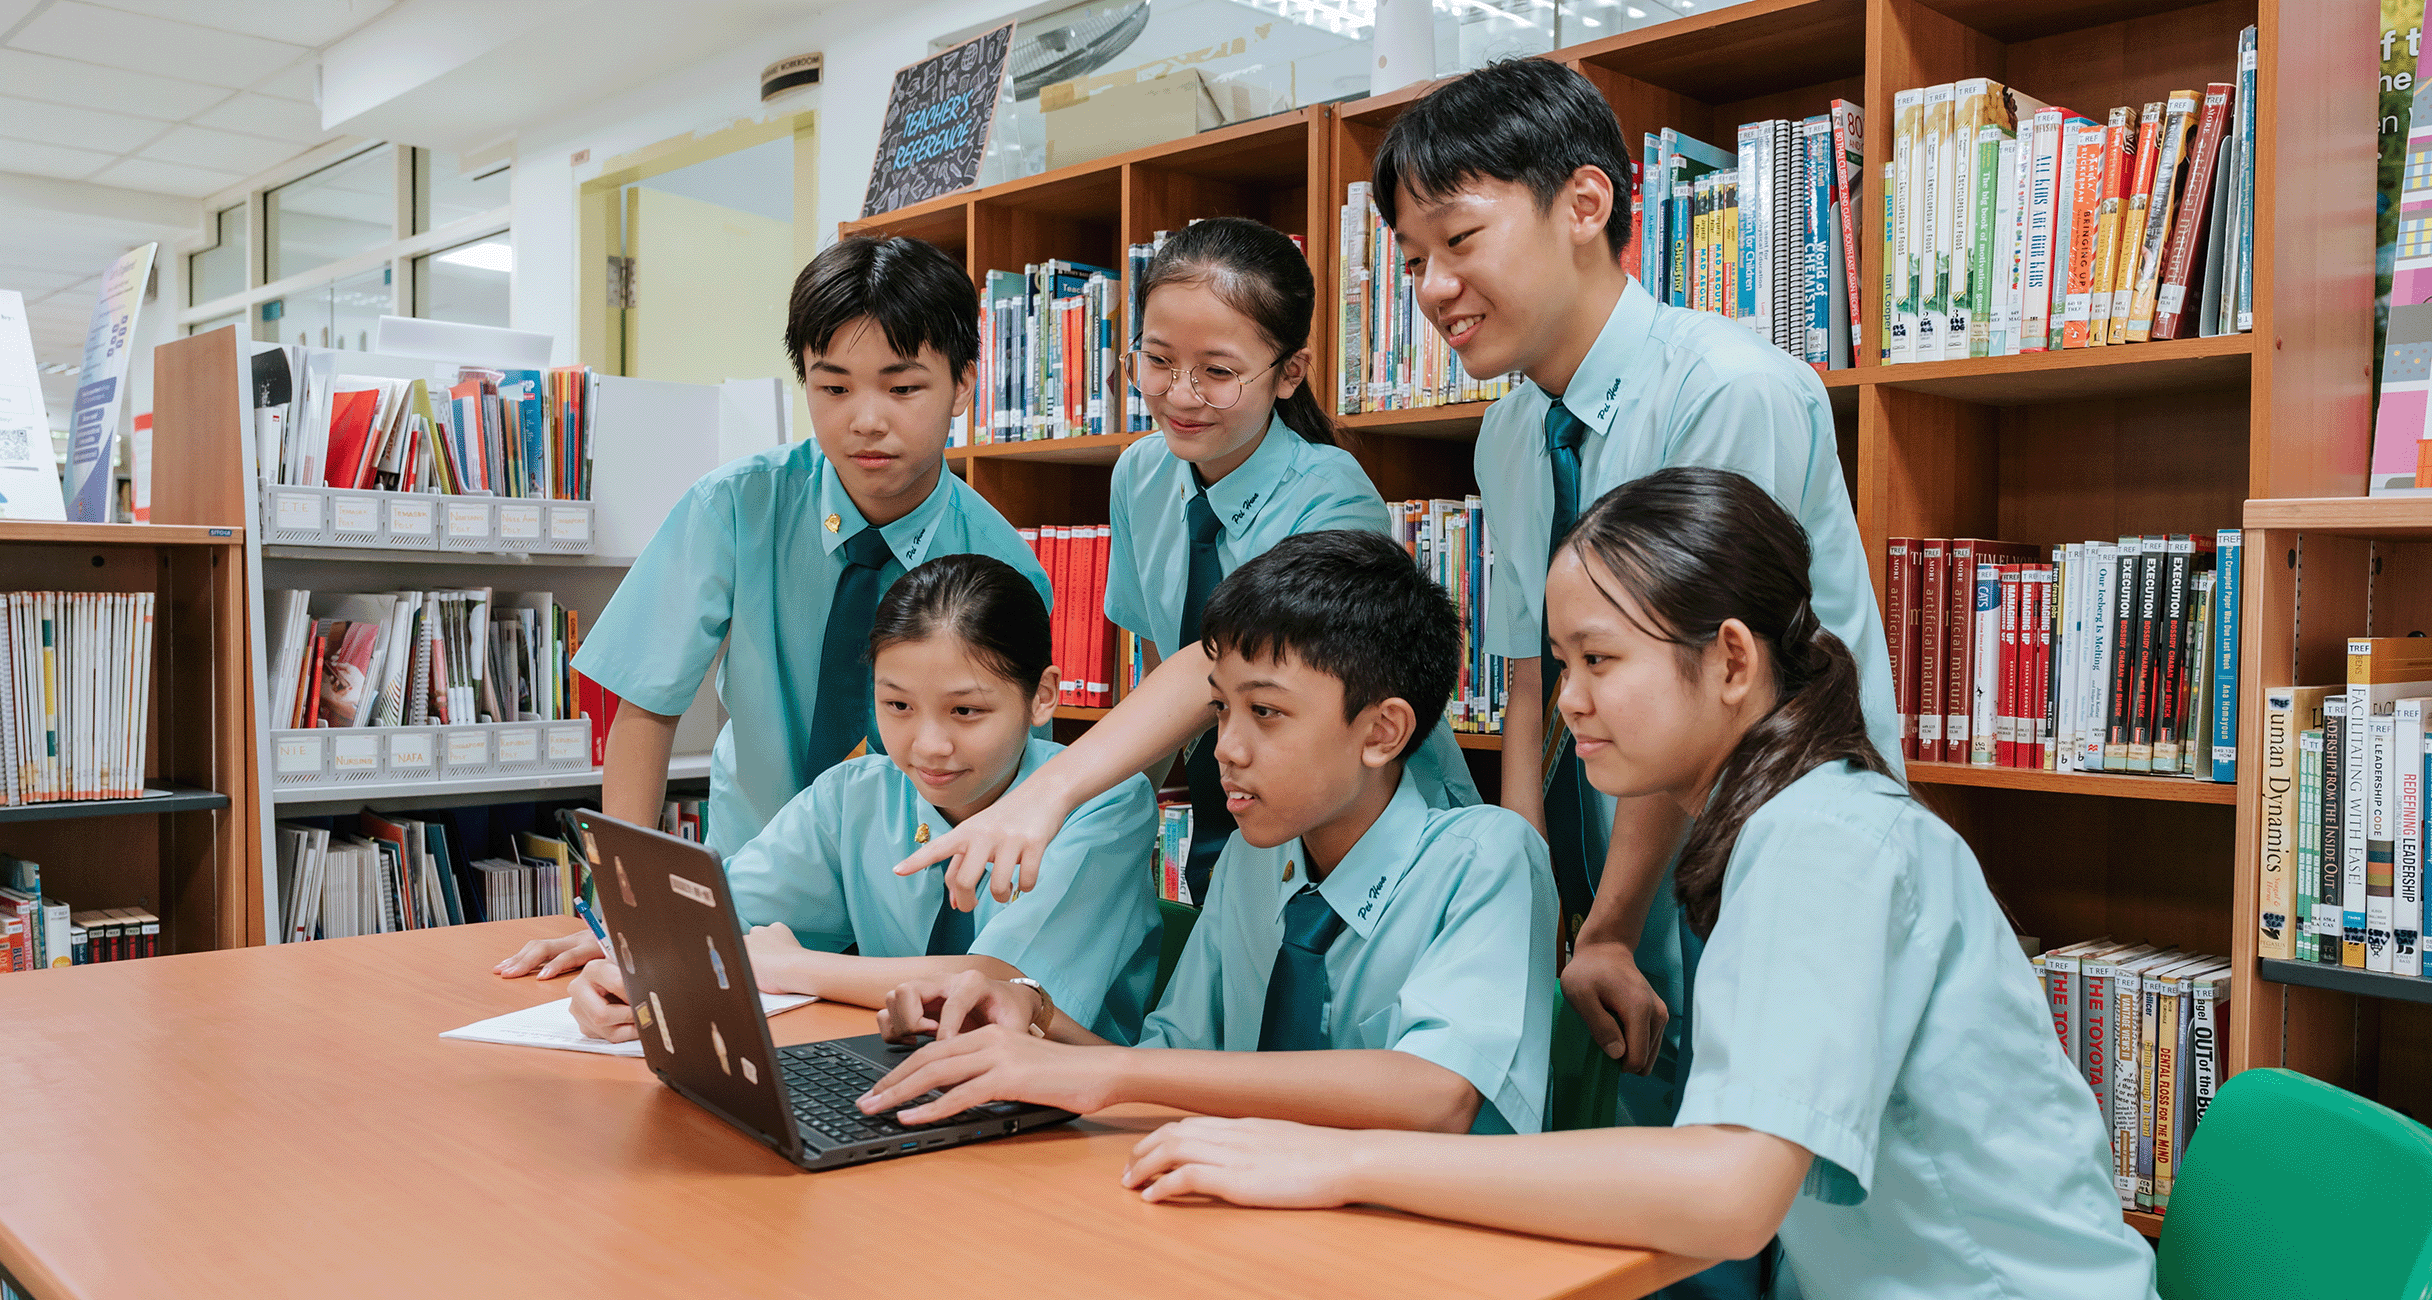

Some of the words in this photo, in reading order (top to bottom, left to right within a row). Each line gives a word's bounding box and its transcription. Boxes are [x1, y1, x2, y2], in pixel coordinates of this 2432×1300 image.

[903, 88, 973, 138] TEACHER'S
[1847, 112, 1863, 139] 80
[893, 119, 972, 170] REFERENCE
[1835, 131, 1843, 142] 80
[1836, 142, 1845, 159] THAI
[1838, 160, 1848, 190] CURRIES
[2035, 156, 2052, 176] ALL
[2078, 148, 2087, 203] RUCKERMAN
[1982, 172, 1990, 188] The
[2034, 179, 2050, 205] KIDS
[1841, 192, 1850, 206] AND
[1980, 191, 1989, 206] big
[1843, 208, 1852, 231] CLASSIC
[1980, 208, 1989, 230] book
[2033, 211, 2047, 229] ARE
[1980, 232, 1988, 242] of
[2031, 234, 2047, 257] OUR
[2080, 211, 2091, 267] BRINGING
[1815, 241, 1827, 279] World
[1844, 233, 1855, 271] SOUTH-EAST
[1977, 244, 1987, 291] motivation
[2029, 262, 2045, 287] KIDS
[2079, 272, 2086, 286] UP
[1804, 243, 1815, 330] CHEMISTRY
[1815, 283, 1827, 295] of
[1847, 272, 1857, 291] ASIAN
[1849, 292, 1859, 316] RECIPES
[2225, 546, 2233, 559] That
[2098, 568, 2107, 587] Our
[2143, 558, 2156, 618] EXECUTION
[2170, 557, 2183, 618] EXECUTION
[2222, 560, 2233, 589] Crumpled
[1977, 586, 1989, 608] CATS
[2120, 559, 2132, 618] EXECUTION
[2222, 591, 2232, 609] Paper
[1925, 589, 1935, 650] artificial
[2007, 585, 2016, 630] MANAGING
[2022, 585, 2031, 630] MANAGING
[2042, 584, 2051, 630] MANAGING
[2095, 589, 2106, 623] Iceberg
[2223, 610, 2231, 622] Was
[1952, 589, 1964, 651] artificial
[2096, 625, 2104, 633] Is
[2223, 625, 2231, 637] Due
[2006, 633, 2014, 645] UP
[2021, 633, 2030, 645] UP
[2041, 633, 2049, 645] UP
[2120, 620, 2128, 649] BOSSIDY
[2142, 620, 2151, 649] BOSSIDY
[2169, 620, 2178, 649] BOSSIDY
[2223, 638, 2231, 651] Last
[2350, 644, 2370, 652] TREF
[2093, 636, 2103, 671] Melting
[2117, 650, 2126, 677] CHARAN
[2140, 651, 2149, 678] CHARAN
[2167, 650, 2176, 678] CHARAN
[2223, 653, 2231, 670] Week
[1923, 656, 1936, 715] maturit
[1950, 657, 1964, 715] maturit
[2222, 684, 2231, 698] Ana
[2115, 693, 2123, 717] BURCK
[2164, 695, 2172, 718] BURCK
[2220, 701, 2230, 740] Homayoun
[2269, 713, 2286, 768] uman
[2326, 716, 2340, 770] EADERSHIP
[2349, 688, 2365, 792] FACILITATING
[398, 752, 424, 764] NAFA
[2326, 771, 2337, 798] FROM
[2374, 744, 2382, 806] LEADERSHIP
[2325, 799, 2337, 823] THE
[2403, 774, 2416, 836] REDEFINING
[2262, 776, 2291, 872] Dynamics
[2349, 799, 2363, 841] WITH
[2373, 809, 2382, 836] CODE
[2324, 826, 2338, 861] INSIDE
[2323, 865, 2338, 889] OUT
[2348, 848, 2363, 885] EASE!
[2402, 838, 2416, 903] LEADERSHIP
[2121, 997, 2132, 1030] VANTAGE
[2089, 1016, 2104, 1085] TOYOTA
[2121, 1031, 2131, 1050] VIEWS
[2195, 1027, 2213, 1062] OUT
[2160, 1048, 2171, 1079] DENTAL
[2199, 1060, 2210, 1072] of
[2141, 1069, 2152, 1101] Enough
[2158, 1080, 2169, 1105] FLOSS
[2143, 1103, 2151, 1113] to
[2159, 1107, 2168, 1121] FOR
[2142, 1115, 2151, 1137] Lead
[2158, 1124, 2167, 1136] THE
